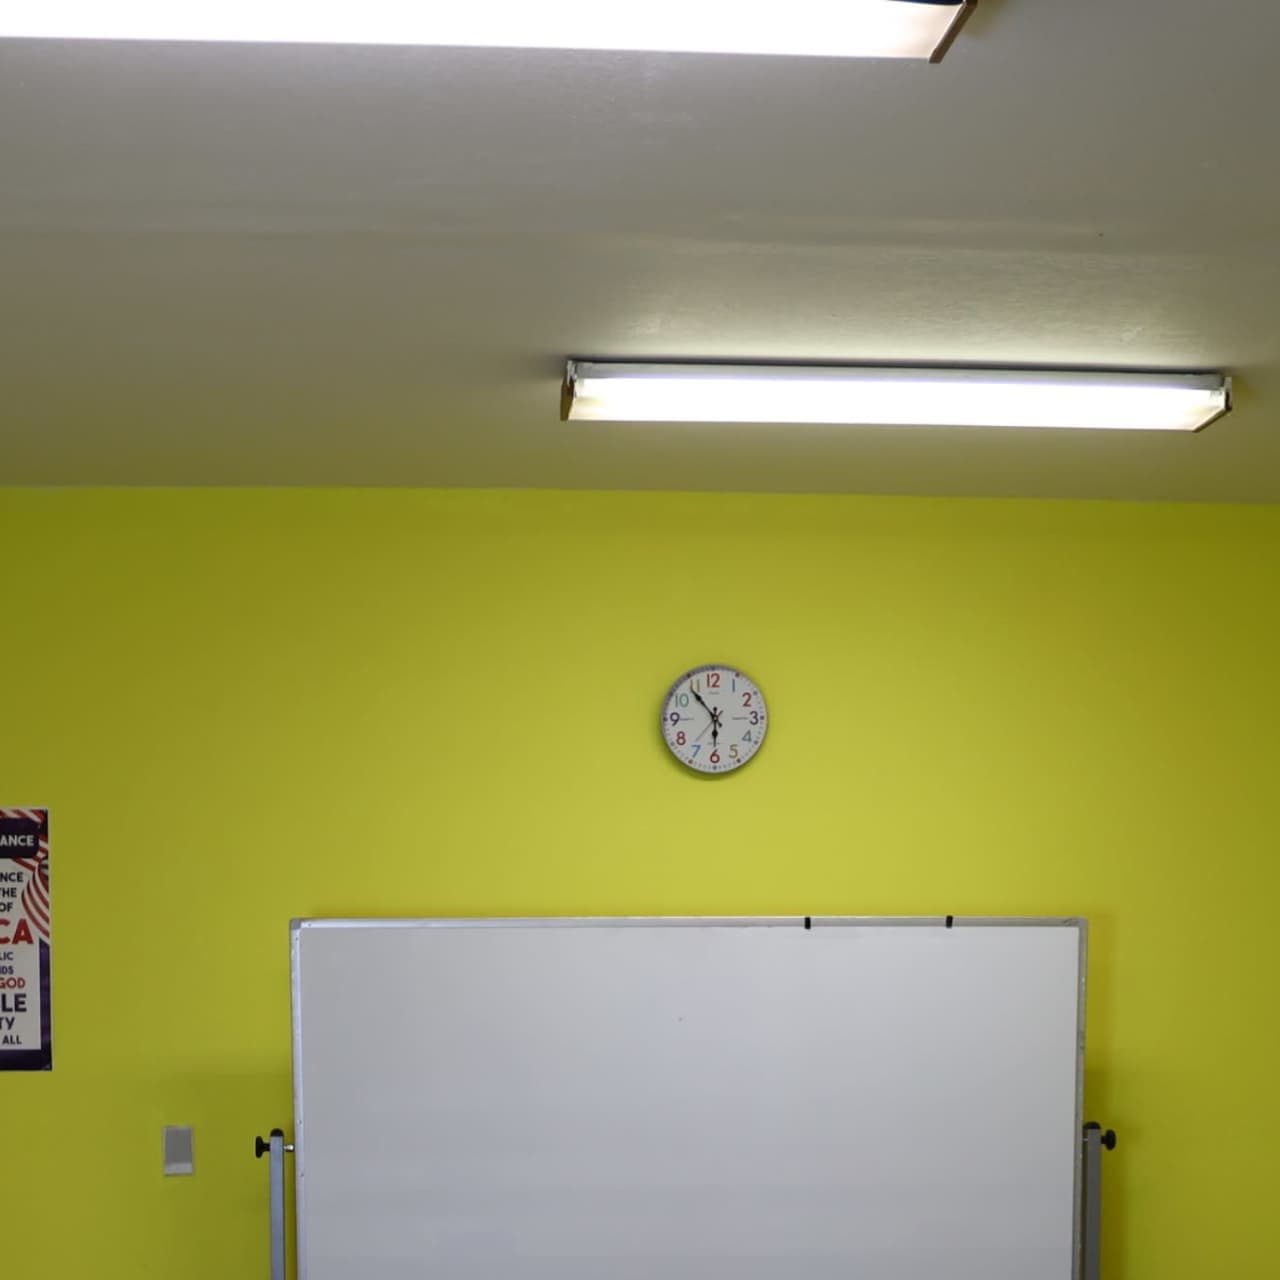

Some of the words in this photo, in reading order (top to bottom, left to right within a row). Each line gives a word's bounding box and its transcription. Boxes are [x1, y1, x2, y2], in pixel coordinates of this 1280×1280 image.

[707, 673, 720, 688] 12
[732, 678, 735, 692] 1
[675, 693, 689, 708] 10
[742, 692, 752, 707] 2
[670, 712, 680, 726] 9
[750, 711, 759, 725] 3
[676, 731, 686, 745] 8
[742, 730, 751, 742] 4
[691, 744, 701, 757] 7
[710, 749, 720, 763] 6
[729, 744, 738, 758] 5
[2, 1035, 22, 1045] ALL
